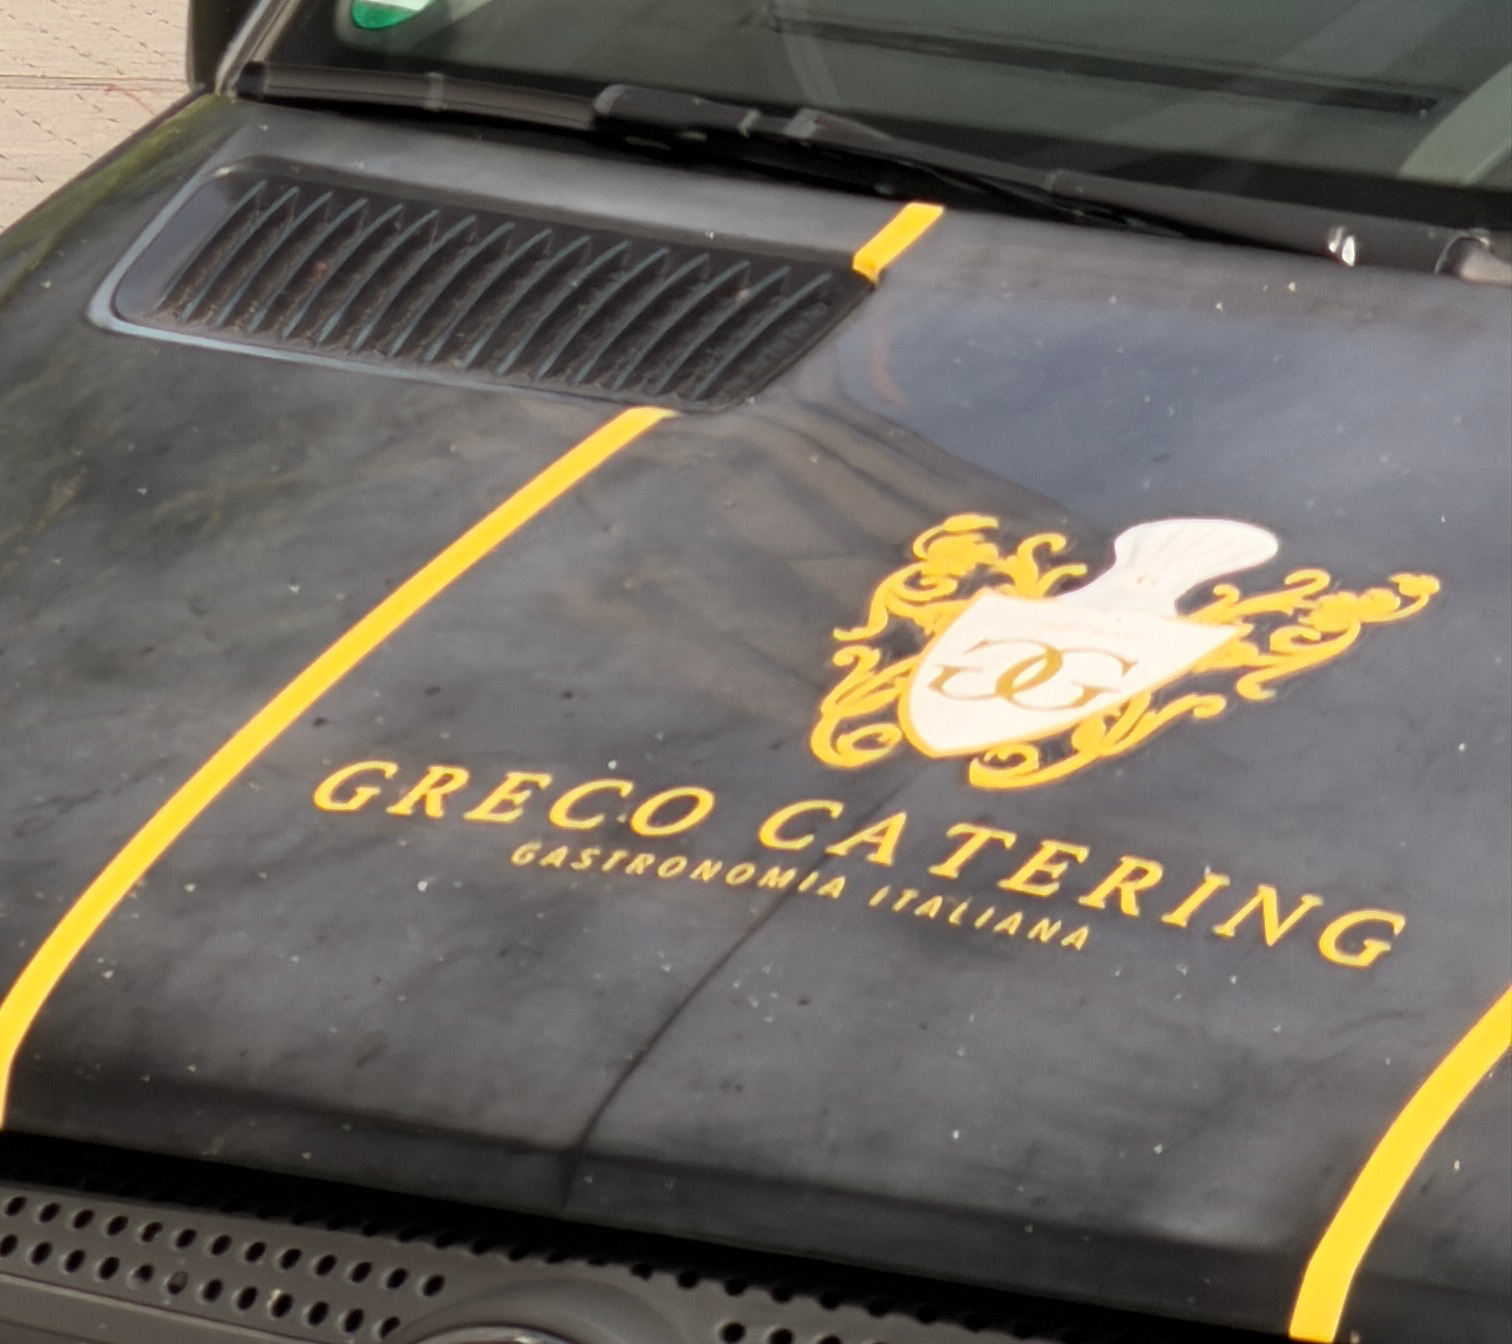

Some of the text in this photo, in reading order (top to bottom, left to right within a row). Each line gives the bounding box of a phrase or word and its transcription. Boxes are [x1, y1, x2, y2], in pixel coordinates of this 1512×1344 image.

[312, 759, 1407, 968] GRECO CATERING
[510, 841, 1090, 952] GASTRONOMIA ITALIANA
